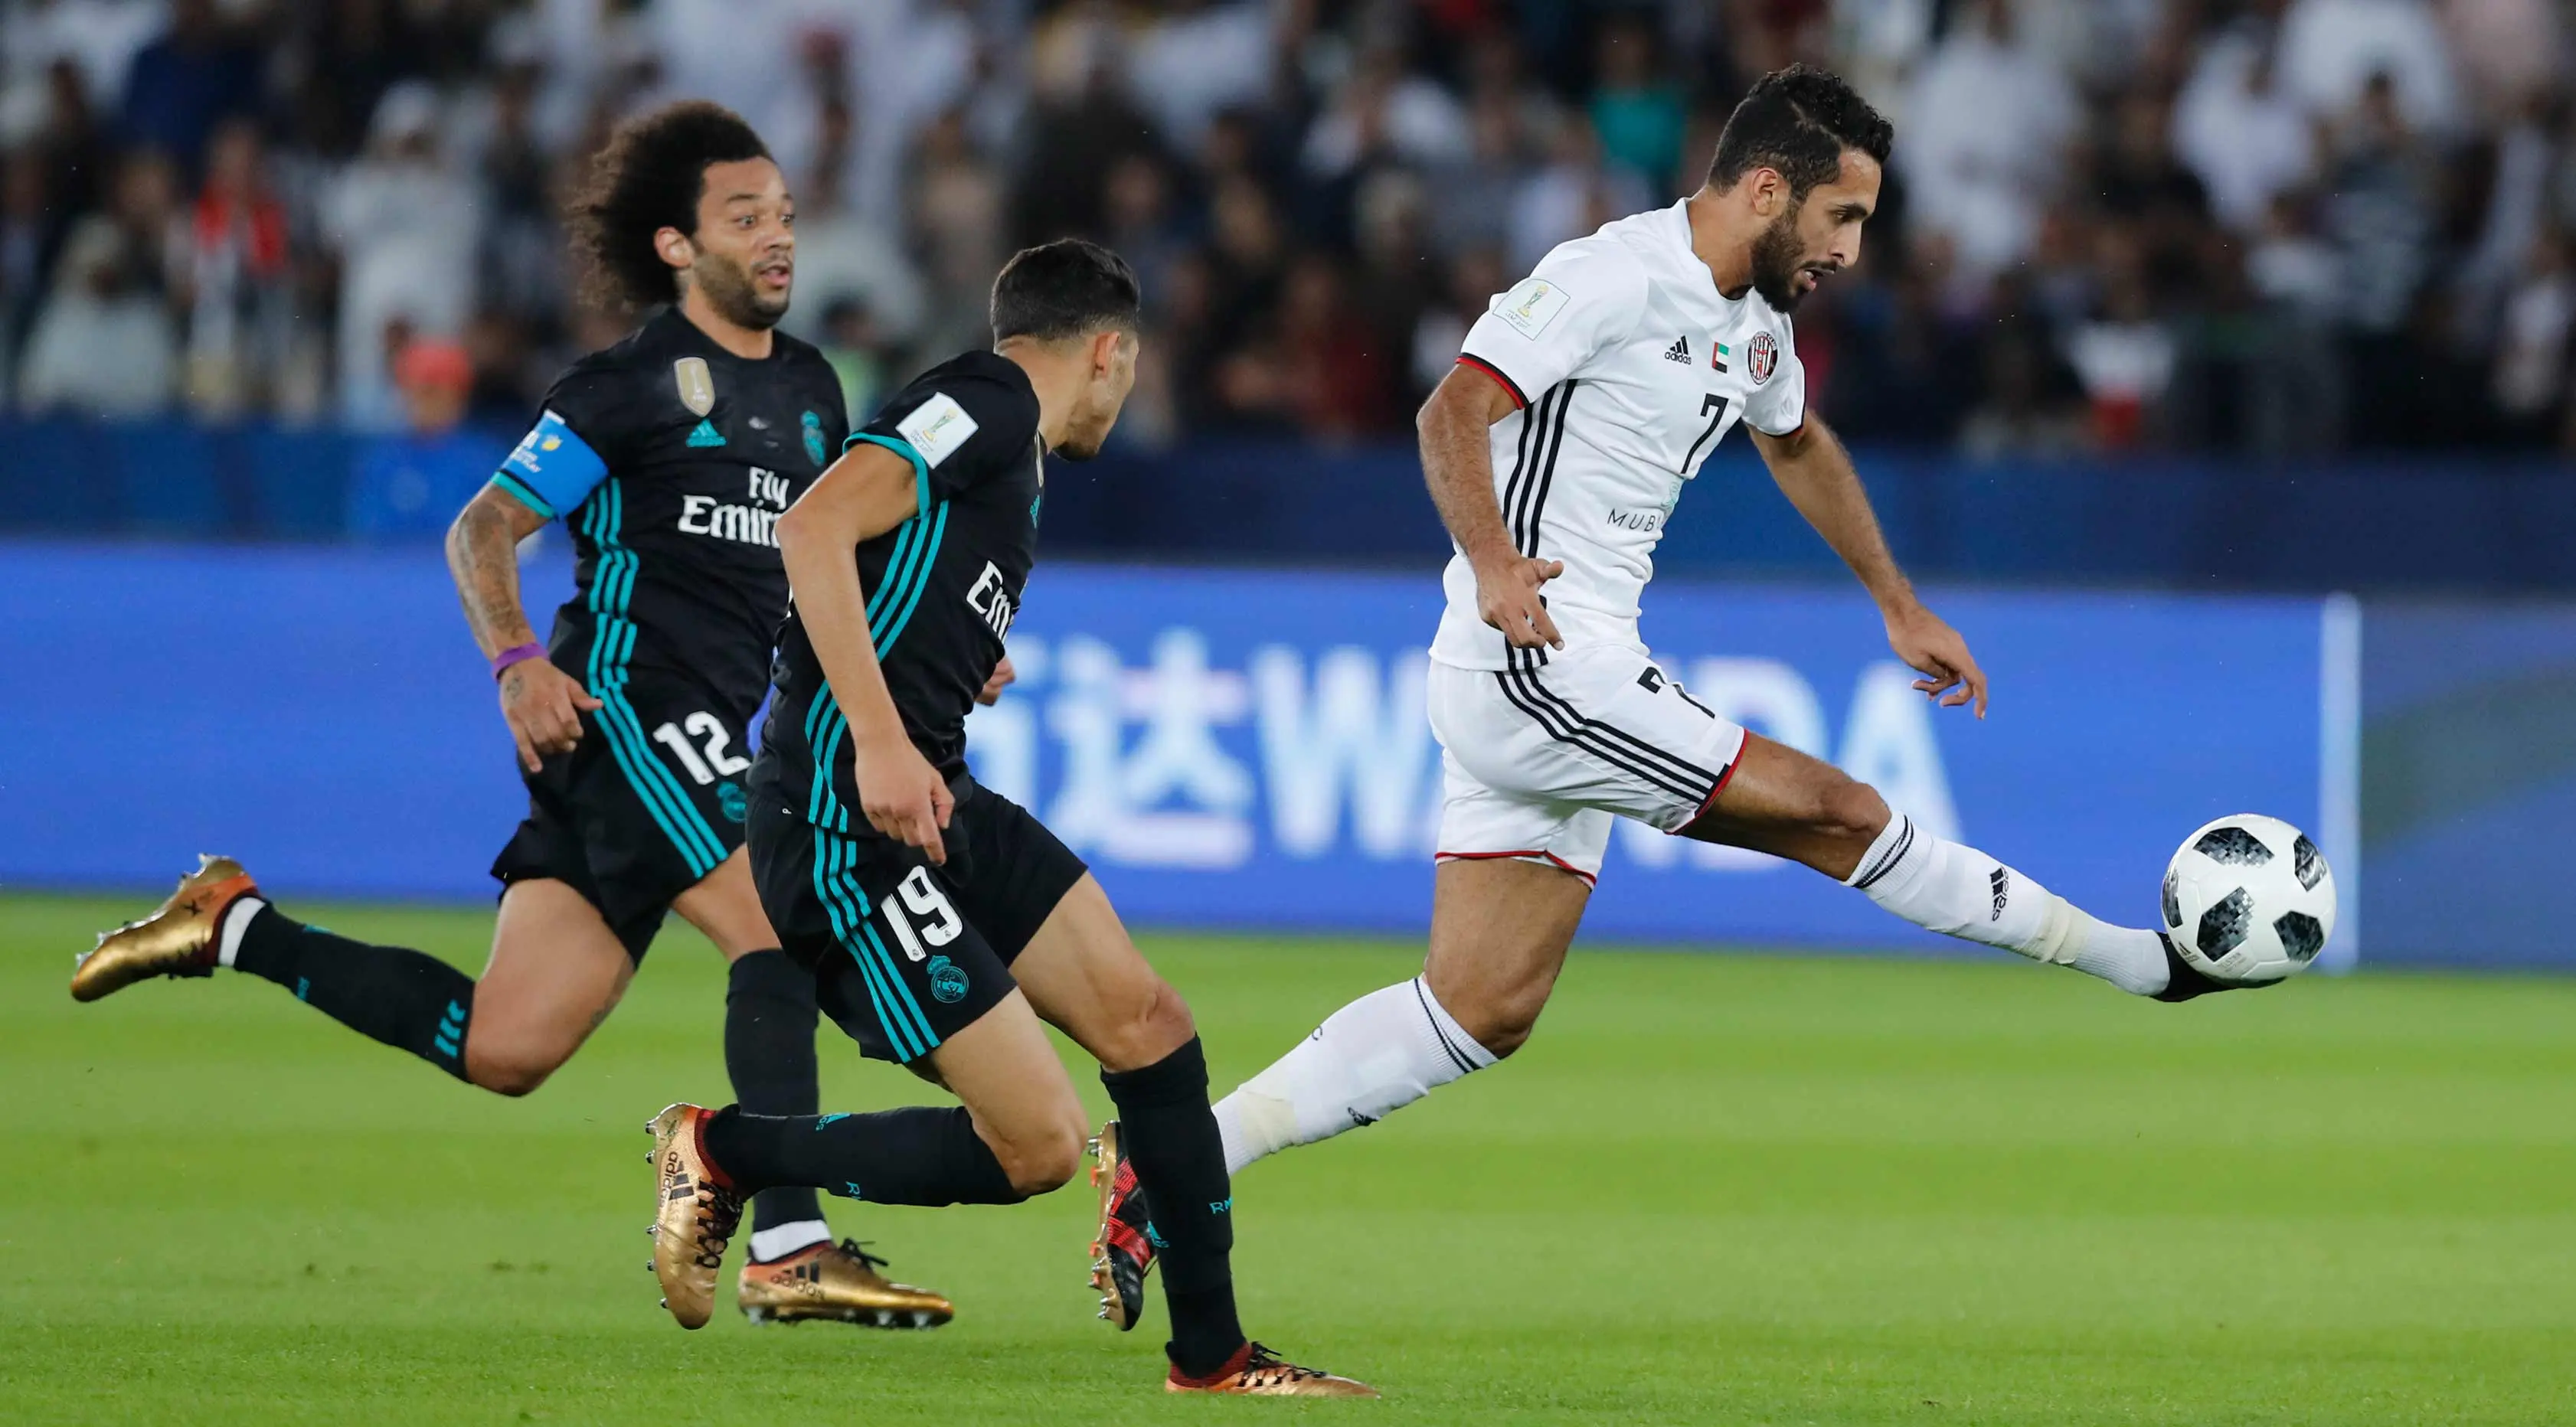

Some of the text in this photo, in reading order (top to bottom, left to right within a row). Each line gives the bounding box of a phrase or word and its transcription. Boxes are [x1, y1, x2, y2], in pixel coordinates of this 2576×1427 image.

[1664, 351, 1692, 365] adidas
[1680, 393, 1729, 475] 7
[748, 465, 790, 511] Fly
[652, 710, 752, 785] 12
[880, 864, 963, 962] 19
